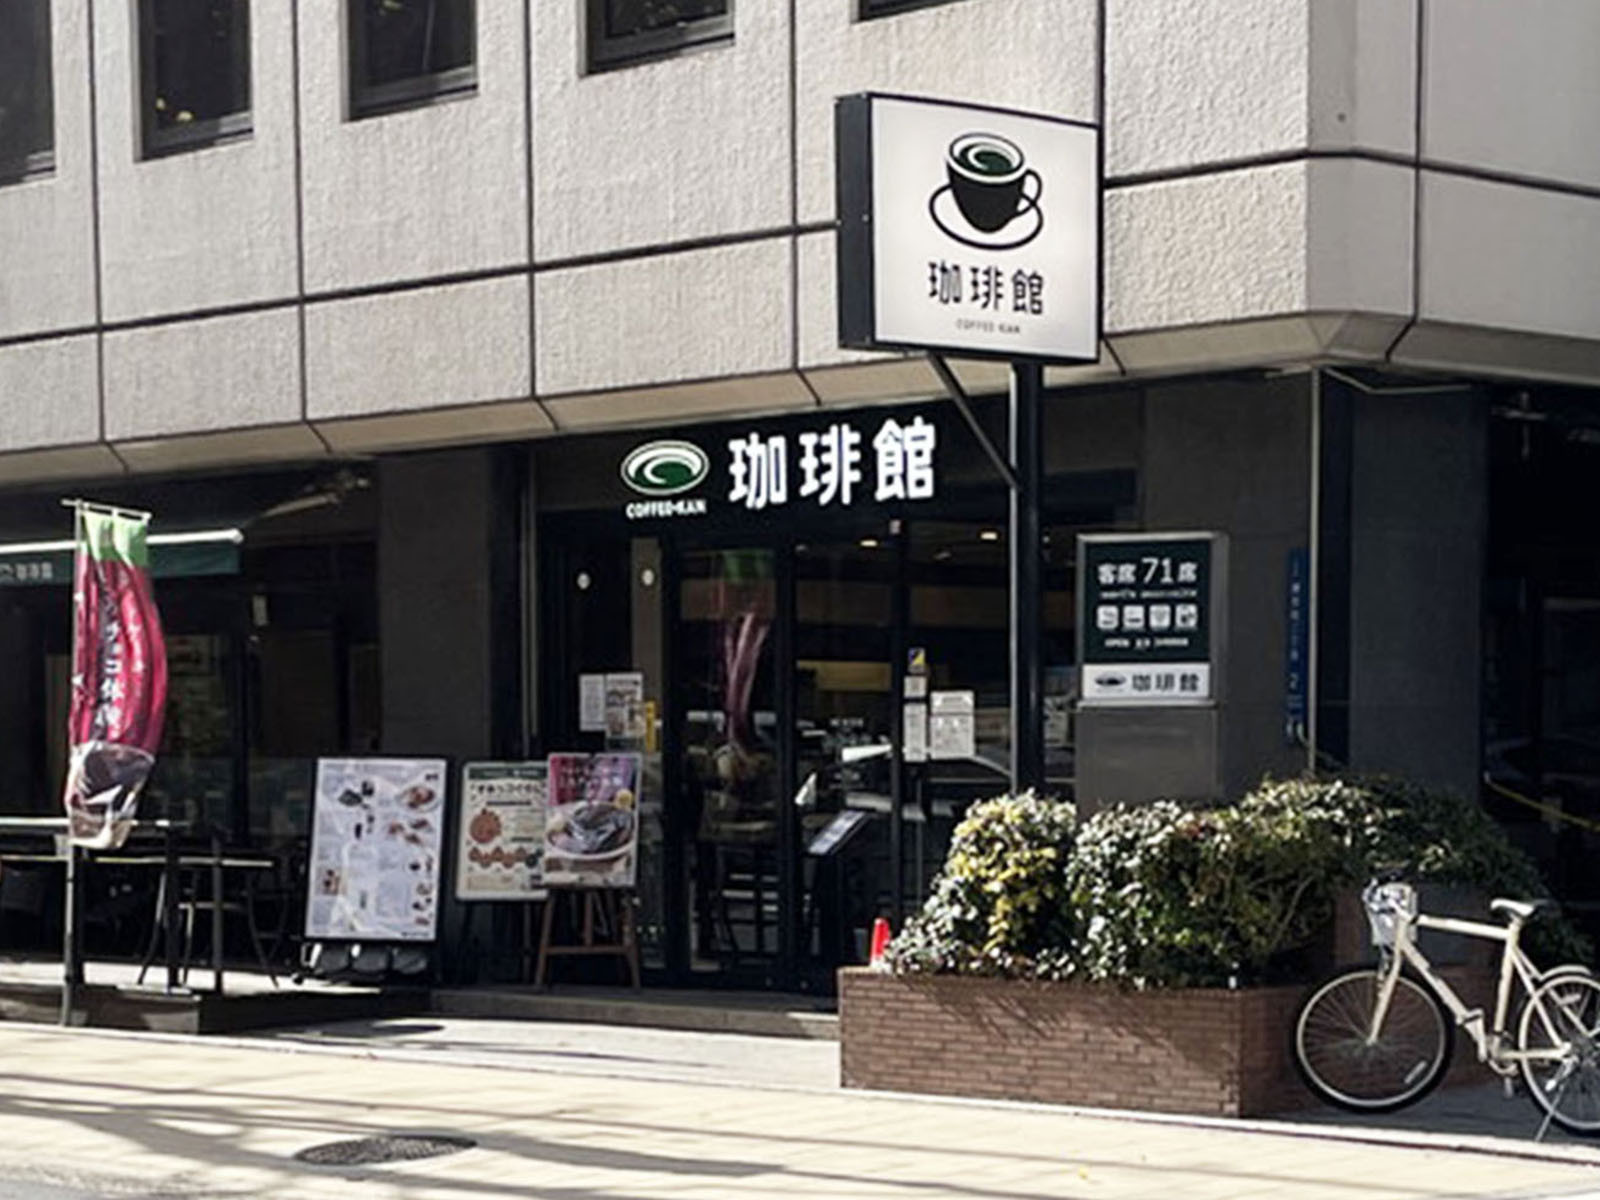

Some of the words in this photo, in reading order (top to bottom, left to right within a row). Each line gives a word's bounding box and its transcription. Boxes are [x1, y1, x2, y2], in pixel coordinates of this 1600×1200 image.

[929, 260, 1044, 315] 珈琲館
[728, 416, 936, 509] 珈琲館
